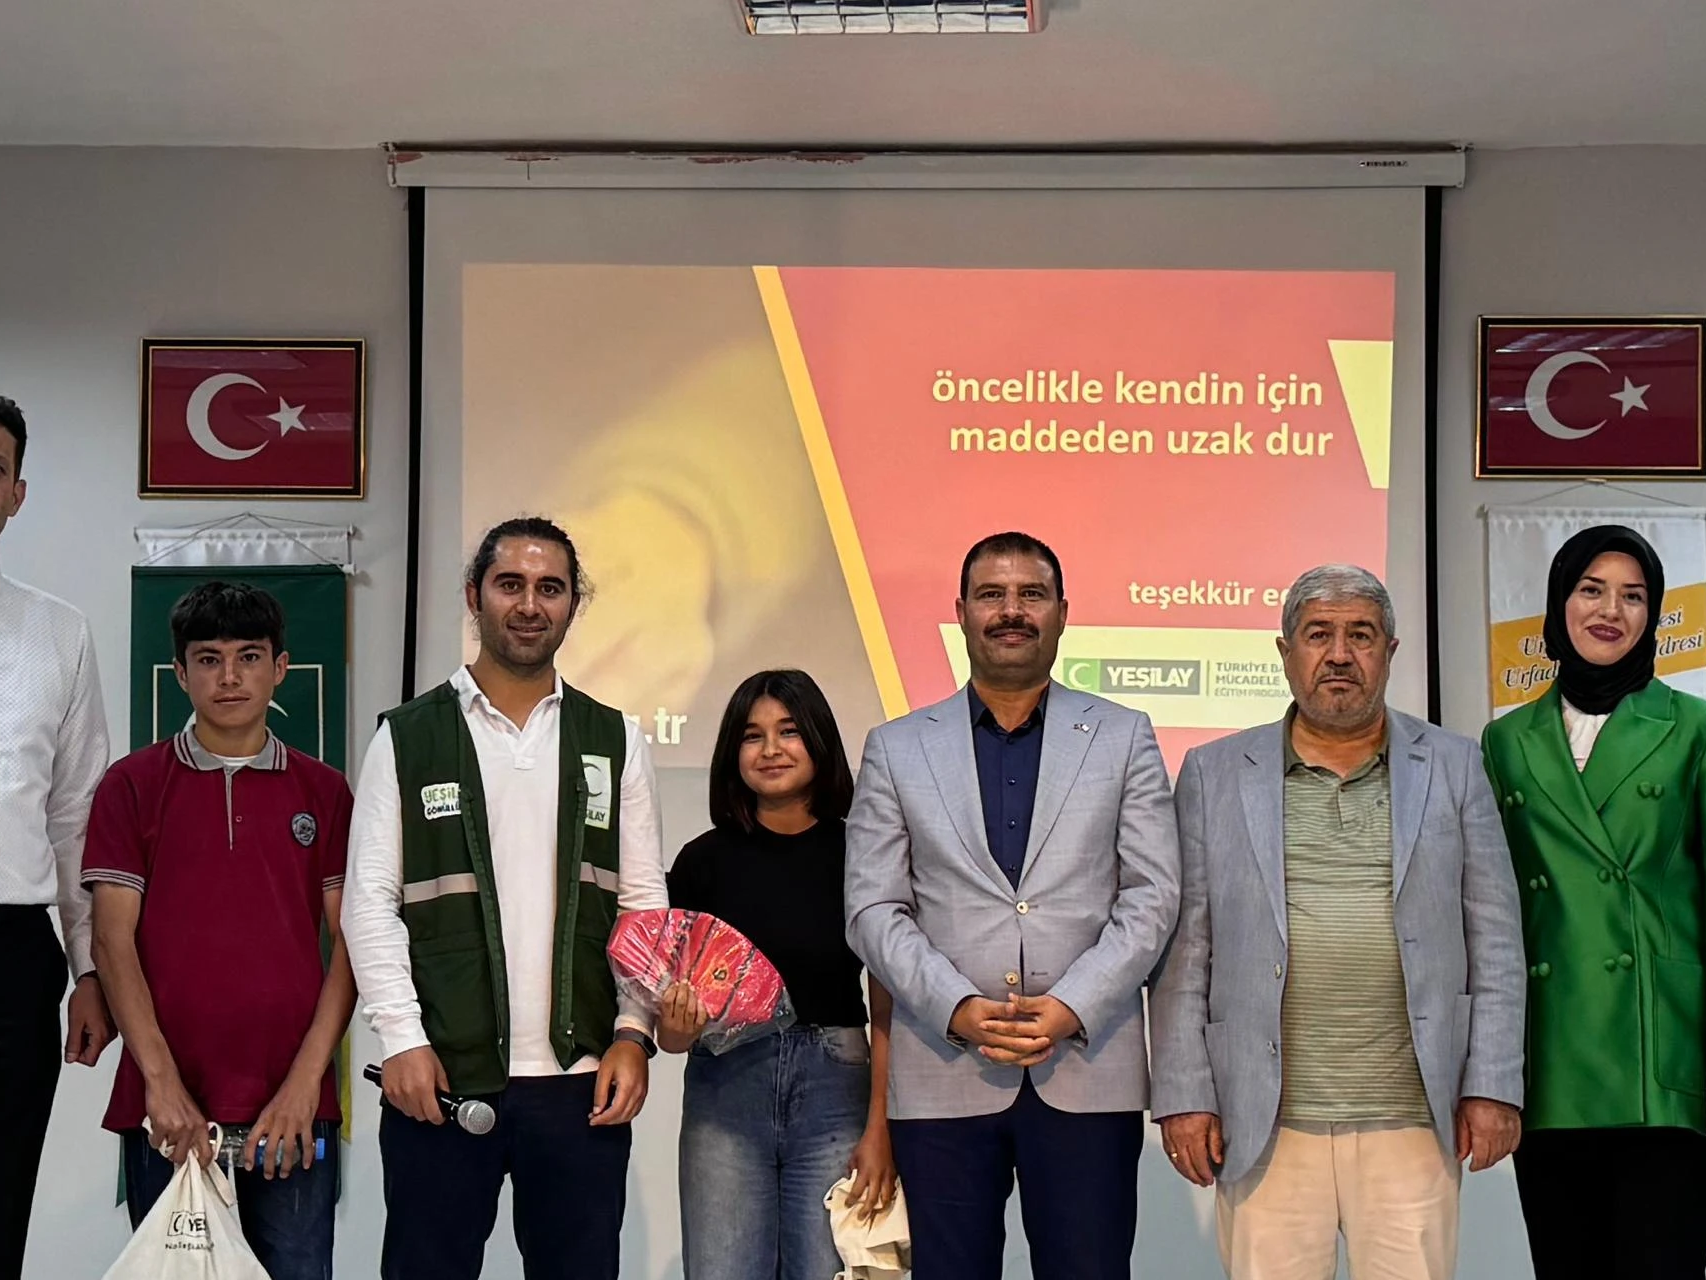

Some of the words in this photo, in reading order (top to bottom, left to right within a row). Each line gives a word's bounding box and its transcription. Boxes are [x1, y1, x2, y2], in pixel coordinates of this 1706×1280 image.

[931, 369, 1104, 405] öncelikle
[1114, 370, 1244, 406] kendin
[1256, 372, 1324, 413] için
[949, 419, 1154, 455] maddeden
[1165, 421, 1254, 456] uzak
[1264, 422, 1334, 457] dur
[1128, 579, 1256, 610] teşekkür
[1216, 661, 1268, 673] TÜRKİYE
[1505, 659, 1558, 691] Urfad
[1655, 630, 1703, 656] dresi
[1106, 665, 1195, 689] YEŞİLAY
[1215, 674, 1281, 686] MÜCADELE
